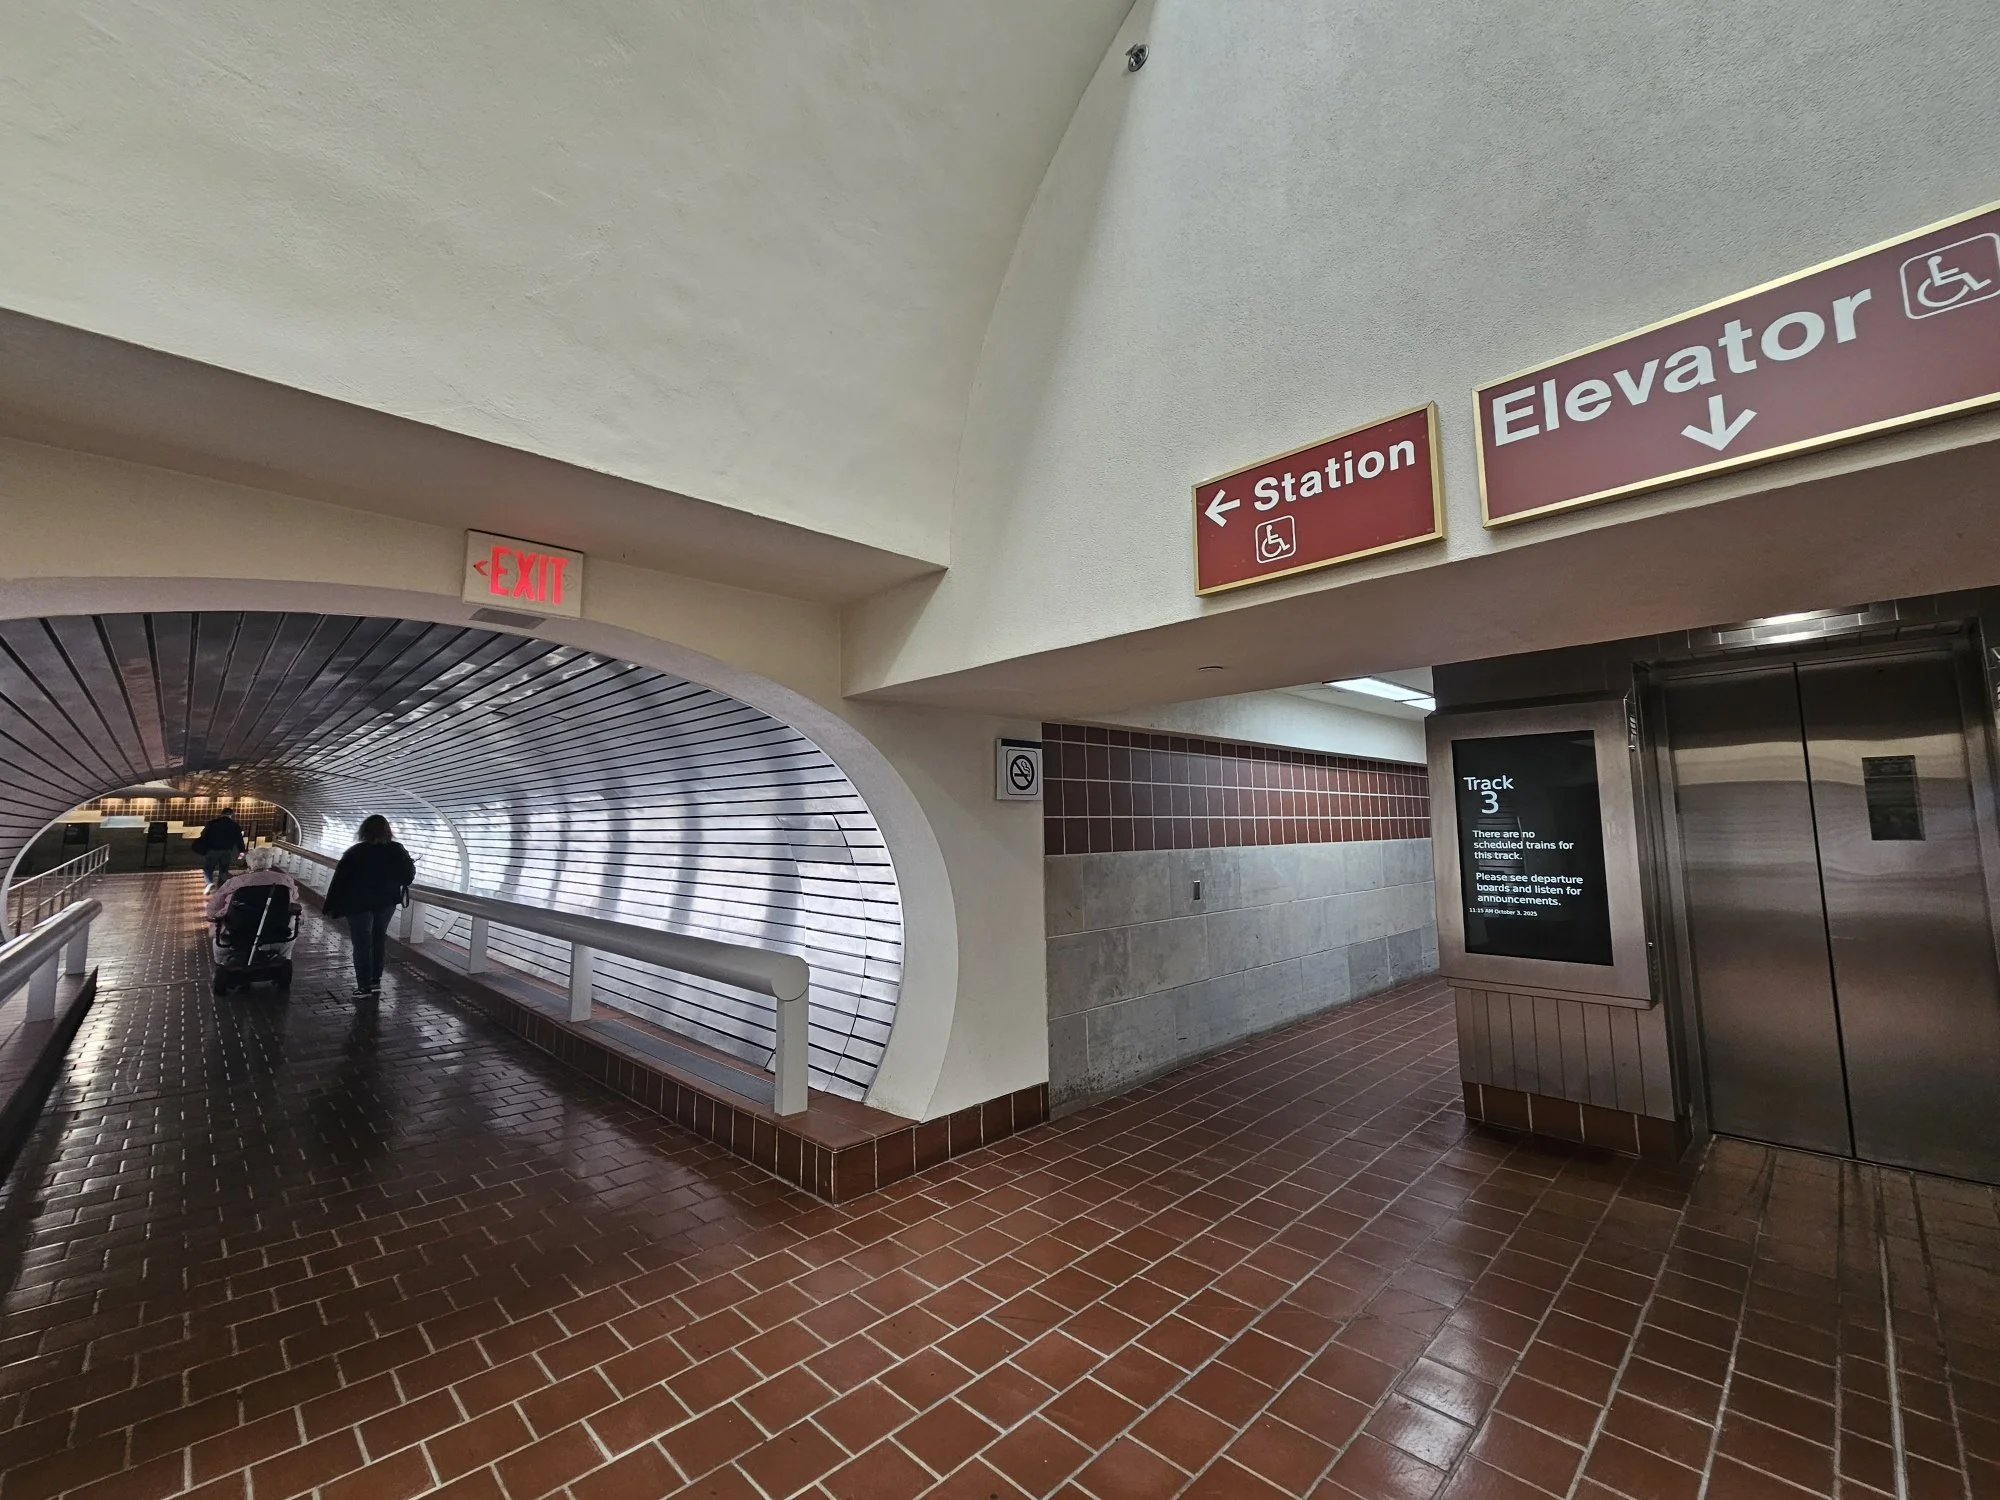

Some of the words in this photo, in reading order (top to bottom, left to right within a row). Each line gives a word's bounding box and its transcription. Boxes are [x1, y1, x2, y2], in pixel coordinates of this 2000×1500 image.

[1493, 288, 1872, 447] Elevator
[1254, 440, 1415, 511] Station
[490, 545, 569, 605] EXIT
[1464, 775, 1514, 791] Track
[1481, 791, 1499, 814] 3
[1472, 830, 1500, 838] There
[1473, 841, 1523, 849] scheduled
[1526, 841, 1556, 849] trains
[1558, 841, 1574, 849] for
[1495, 852, 1523, 860] track.
[1476, 872, 1508, 881] Please
[1509, 874, 1528, 882] see
[1531, 874, 1583, 884] departure
[1477, 883, 1510, 892] boards
[1512, 885, 1531, 893] and
[1534, 885, 1563, 895] listen
[1566, 886, 1582, 895] for
[1477, 895, 1561, 906] announcements.
